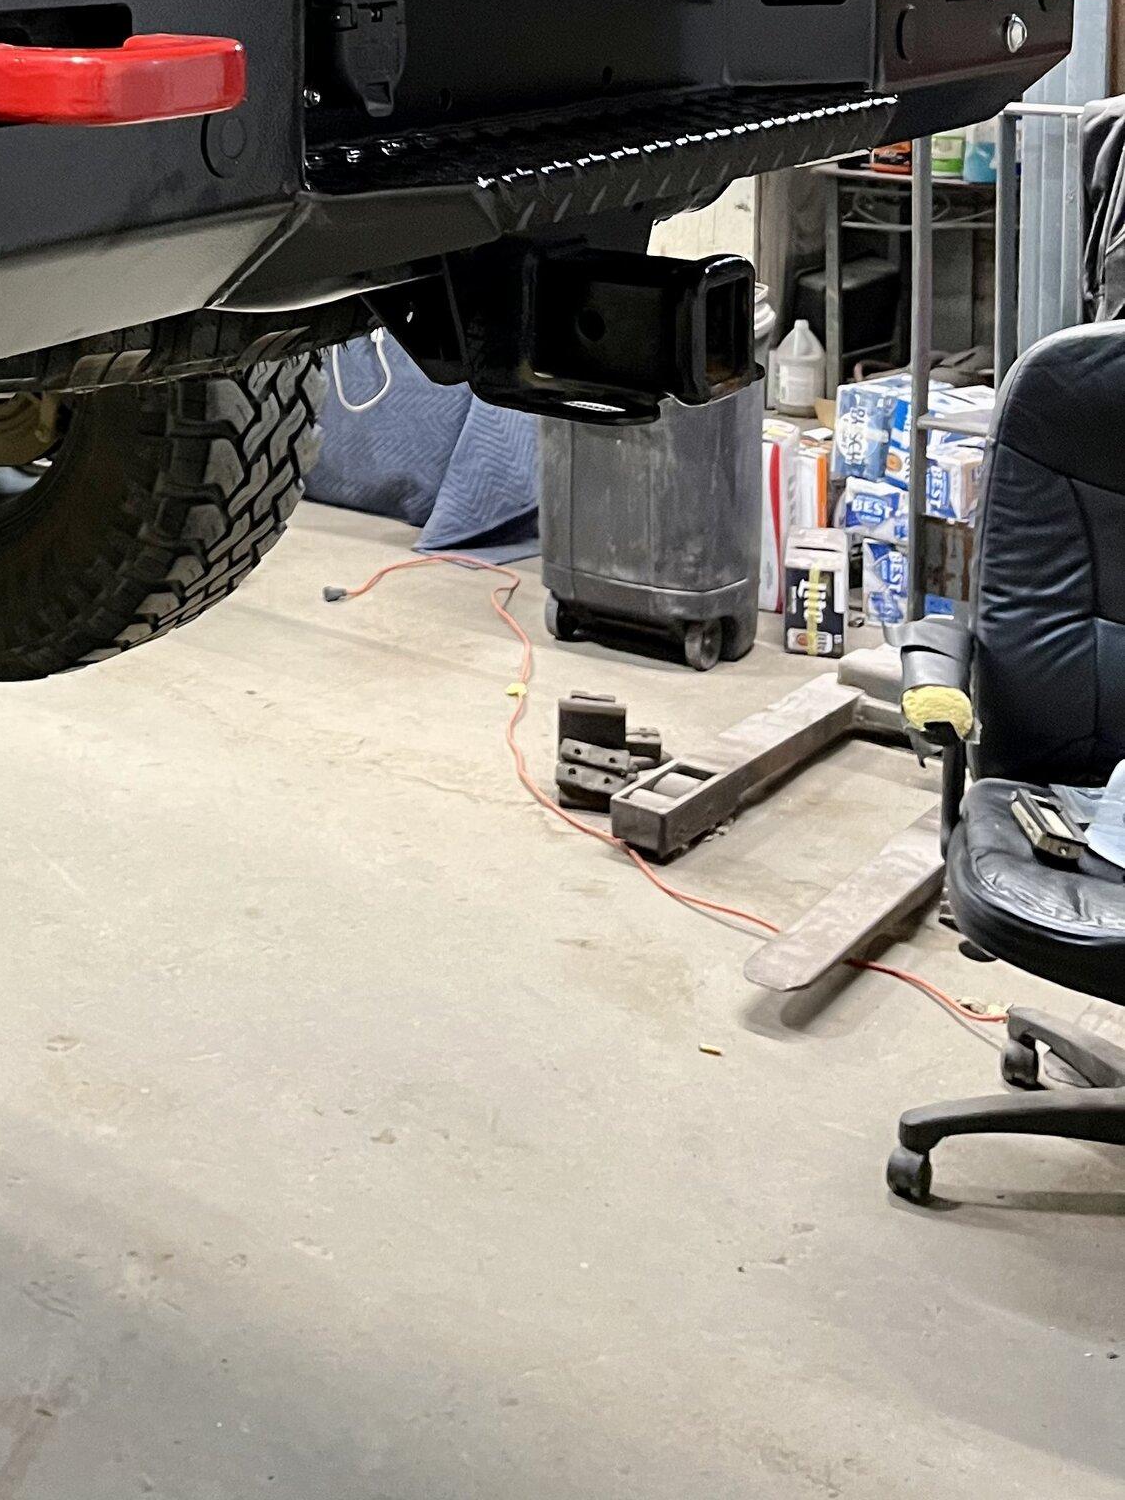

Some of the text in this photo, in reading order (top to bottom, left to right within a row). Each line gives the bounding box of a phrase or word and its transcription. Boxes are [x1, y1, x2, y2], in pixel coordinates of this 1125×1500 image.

[851, 498, 893, 518] BEST
[929, 465, 943, 509] BEST
[888, 551, 903, 593] BEST
